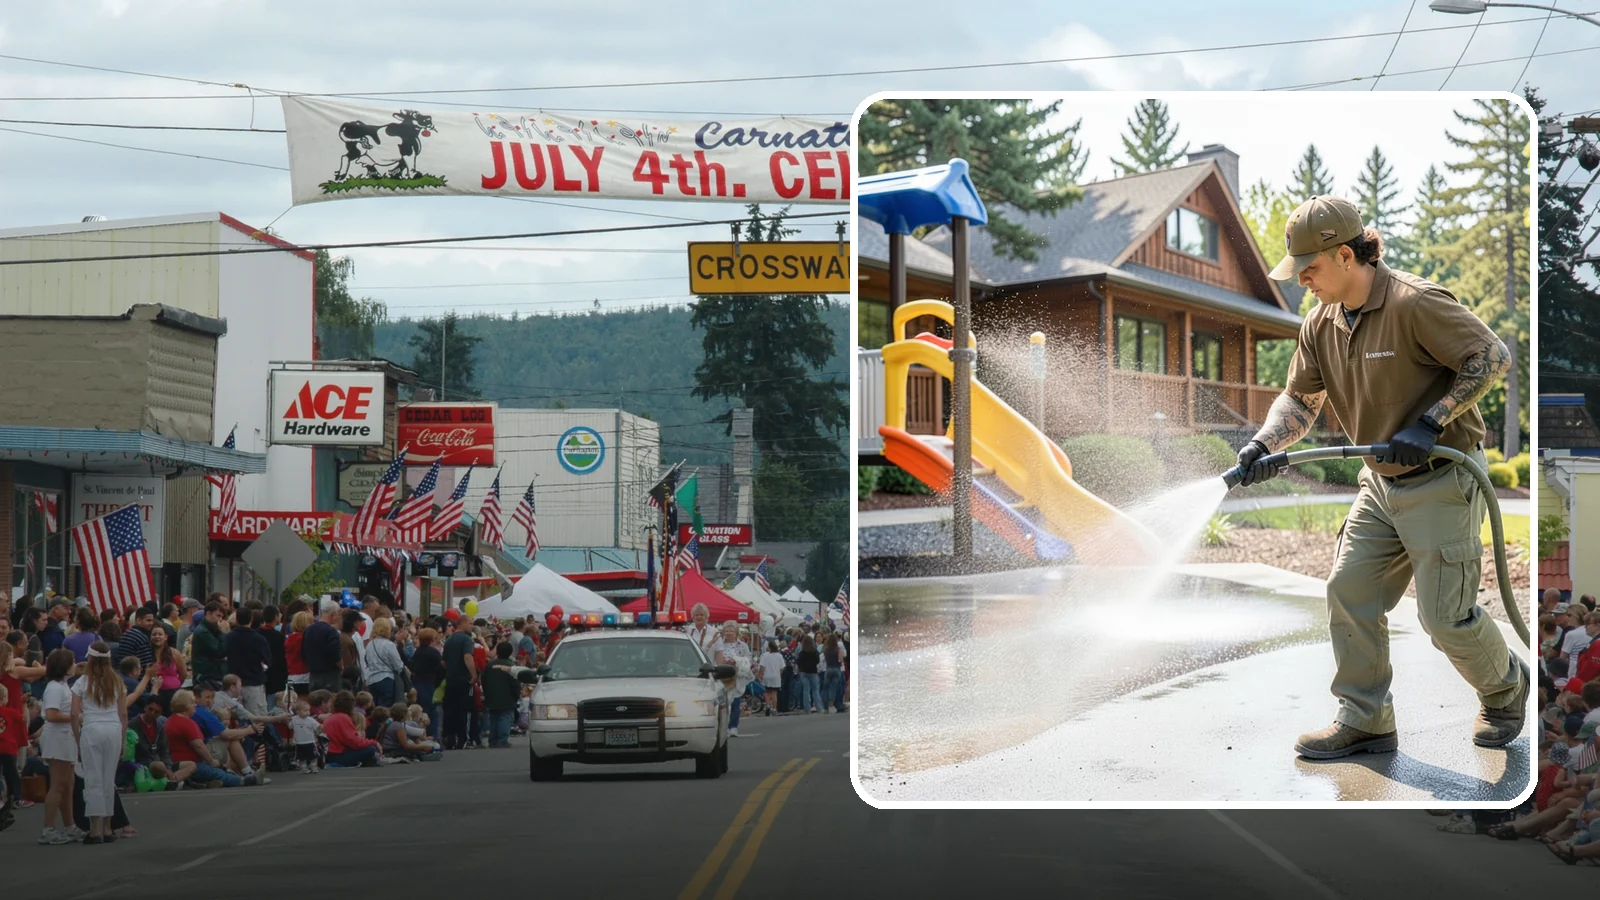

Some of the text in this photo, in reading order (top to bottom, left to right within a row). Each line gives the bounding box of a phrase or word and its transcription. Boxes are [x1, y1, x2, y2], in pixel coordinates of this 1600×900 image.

[481, 141, 605, 192] JULY
[632, 150, 746, 197] 4th.
[697, 255, 850, 279] CROSSWA
[282, 380, 373, 420] ACE
[406, 409, 485, 422] CEDAR LOG
[283, 421, 371, 436] Hardware
[96, 485, 124, 495] Vincent
[126, 486, 136, 495] de
[138, 486, 155, 495] Paul
[699, 535, 730, 544] GLASS
